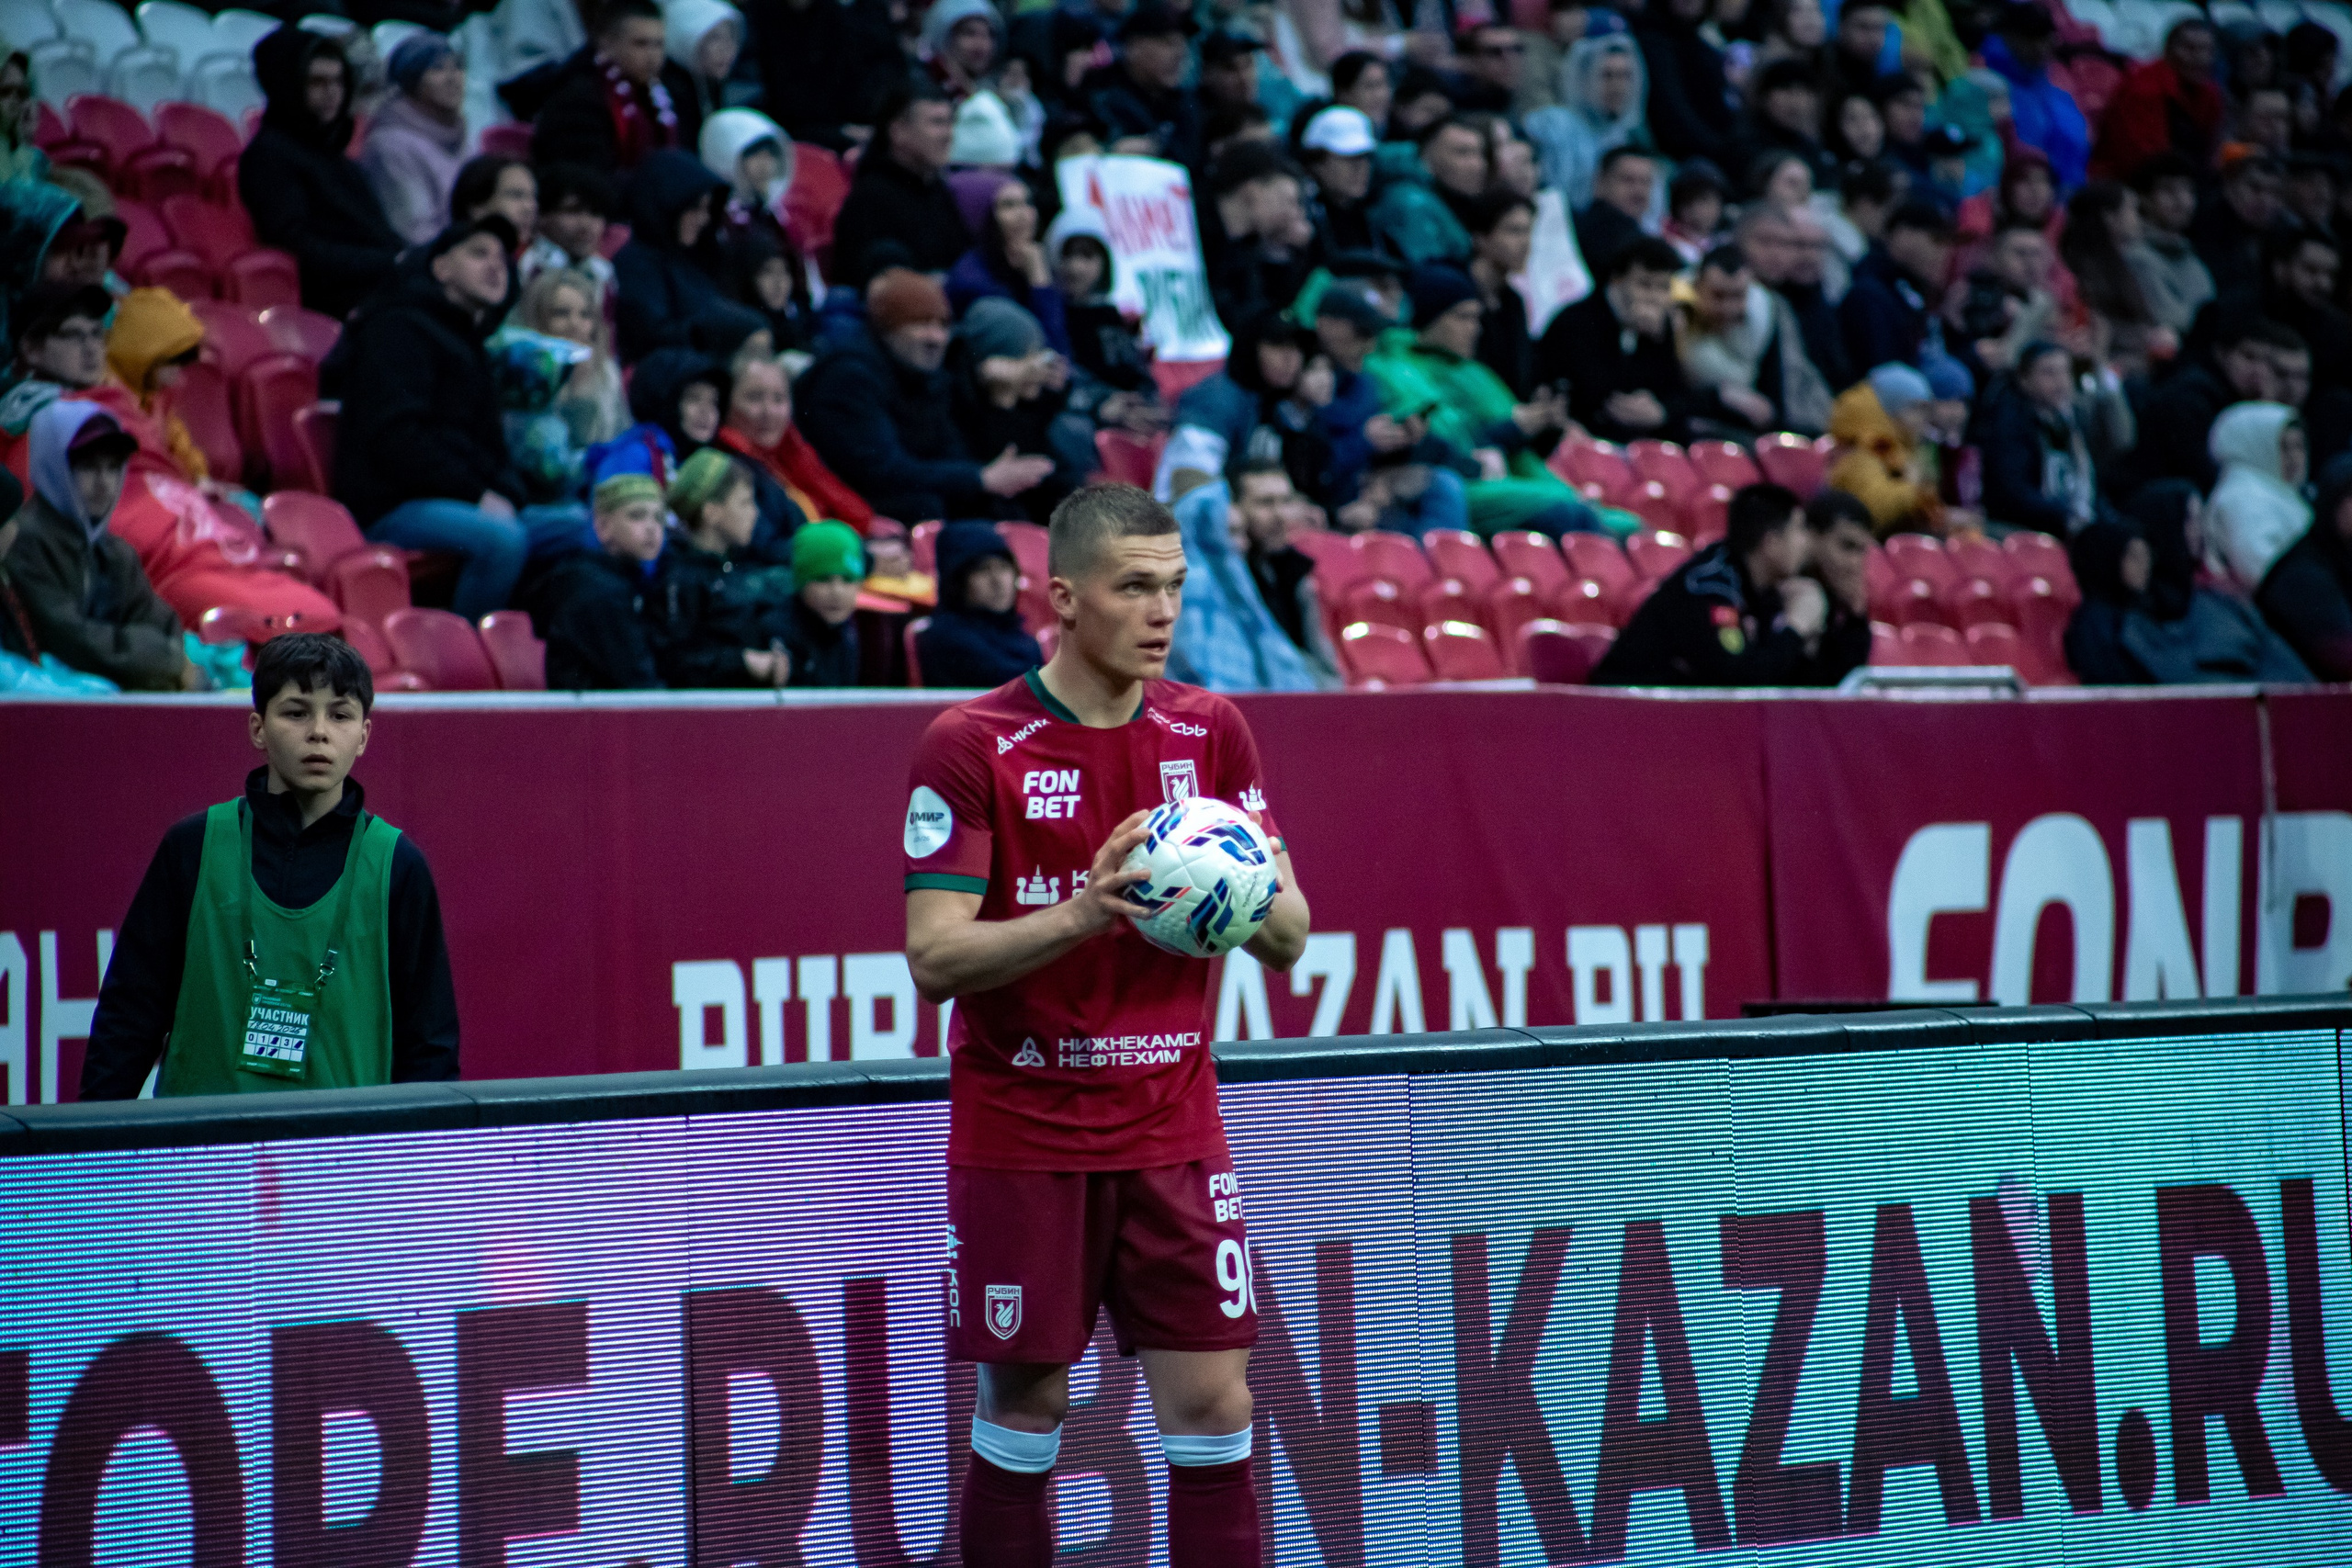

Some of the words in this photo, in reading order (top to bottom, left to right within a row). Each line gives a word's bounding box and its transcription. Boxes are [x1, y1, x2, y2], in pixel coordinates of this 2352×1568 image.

[1161, 761, 1193, 772] РУБИН
[1023, 769, 1080, 794] FON
[1025, 795, 1080, 819] BET
[249, 1006, 310, 1026] УЧАСТНИК
[248, 1033, 254, 1042] 0
[284, 1038, 290, 1046] 3
[1058, 1032, 1201, 1052] НИЖНЕКАМСК
[1058, 1049, 1181, 1067] НЕФТЕХИМ
[987, 1286, 1021, 1295] РУБИН
